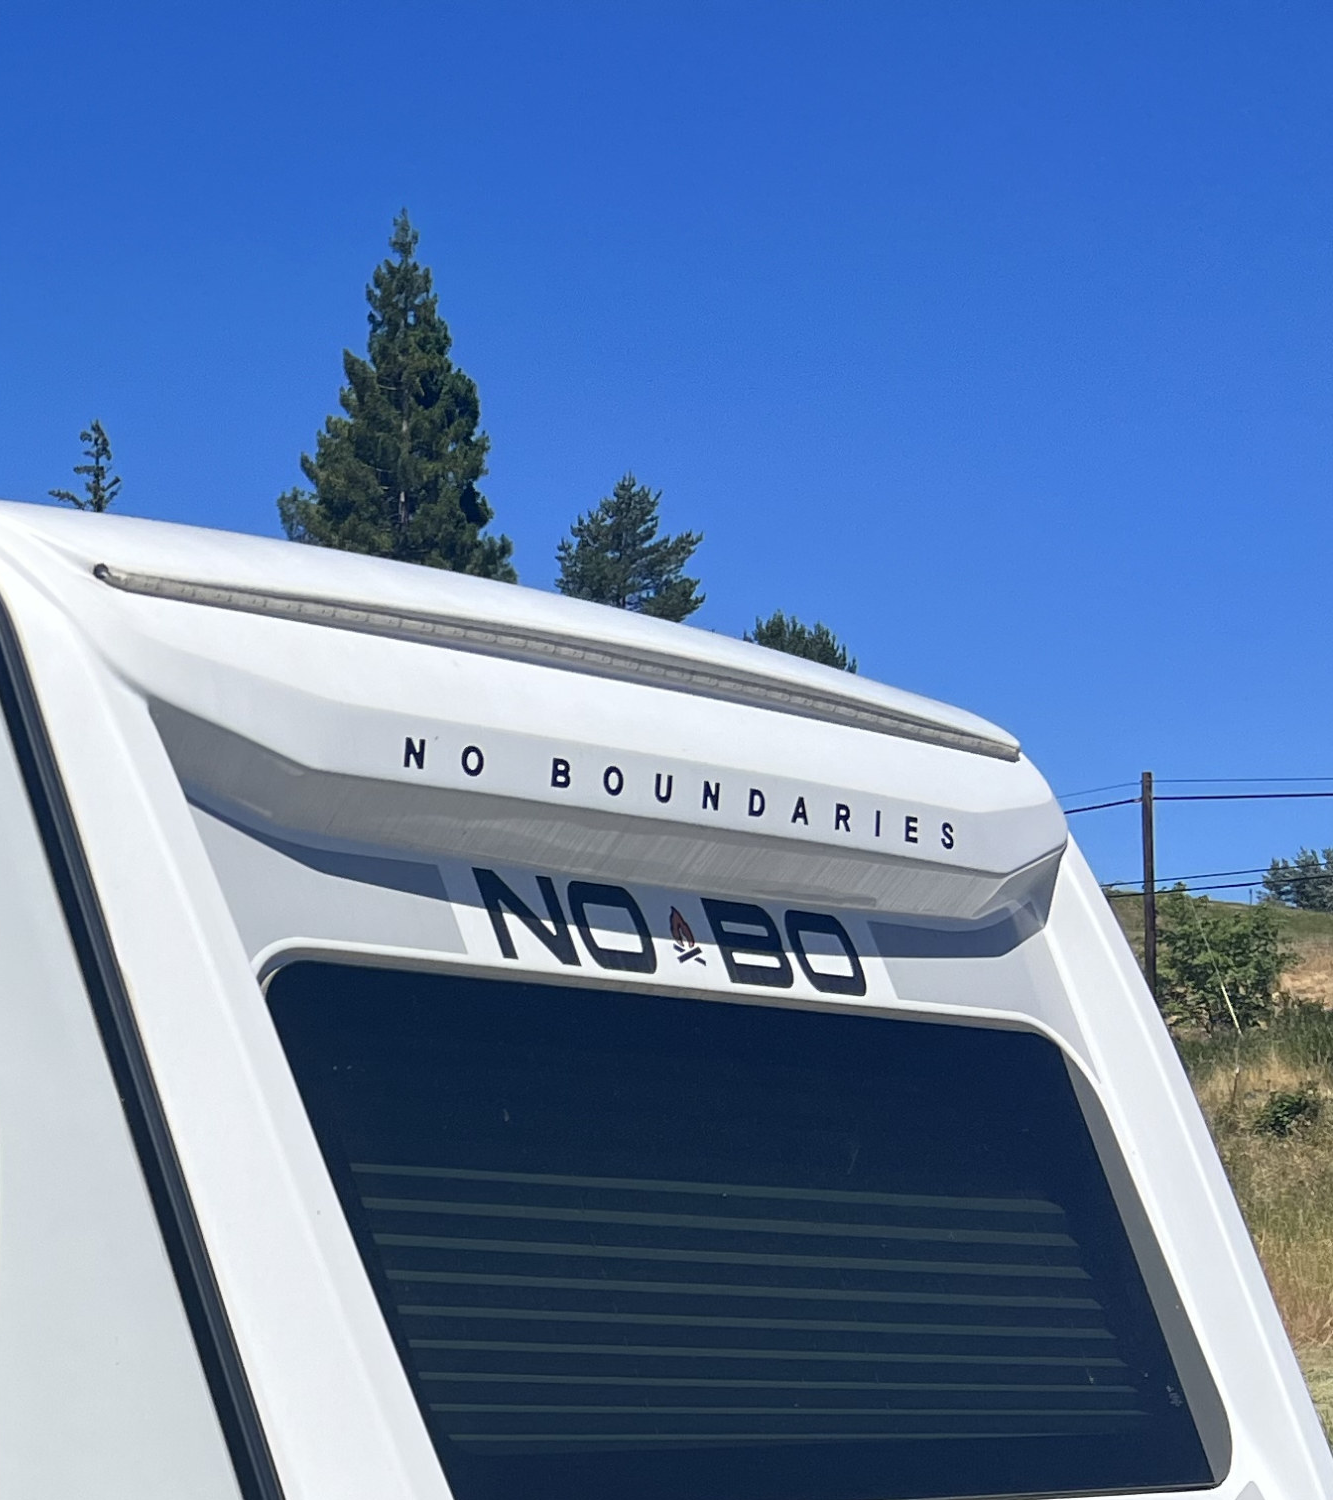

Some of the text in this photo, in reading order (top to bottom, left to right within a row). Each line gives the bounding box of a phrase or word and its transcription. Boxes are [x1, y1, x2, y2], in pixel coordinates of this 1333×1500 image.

[403, 737, 954, 850] NO BOUNDARIES
[471, 867, 867, 997] NO BO
